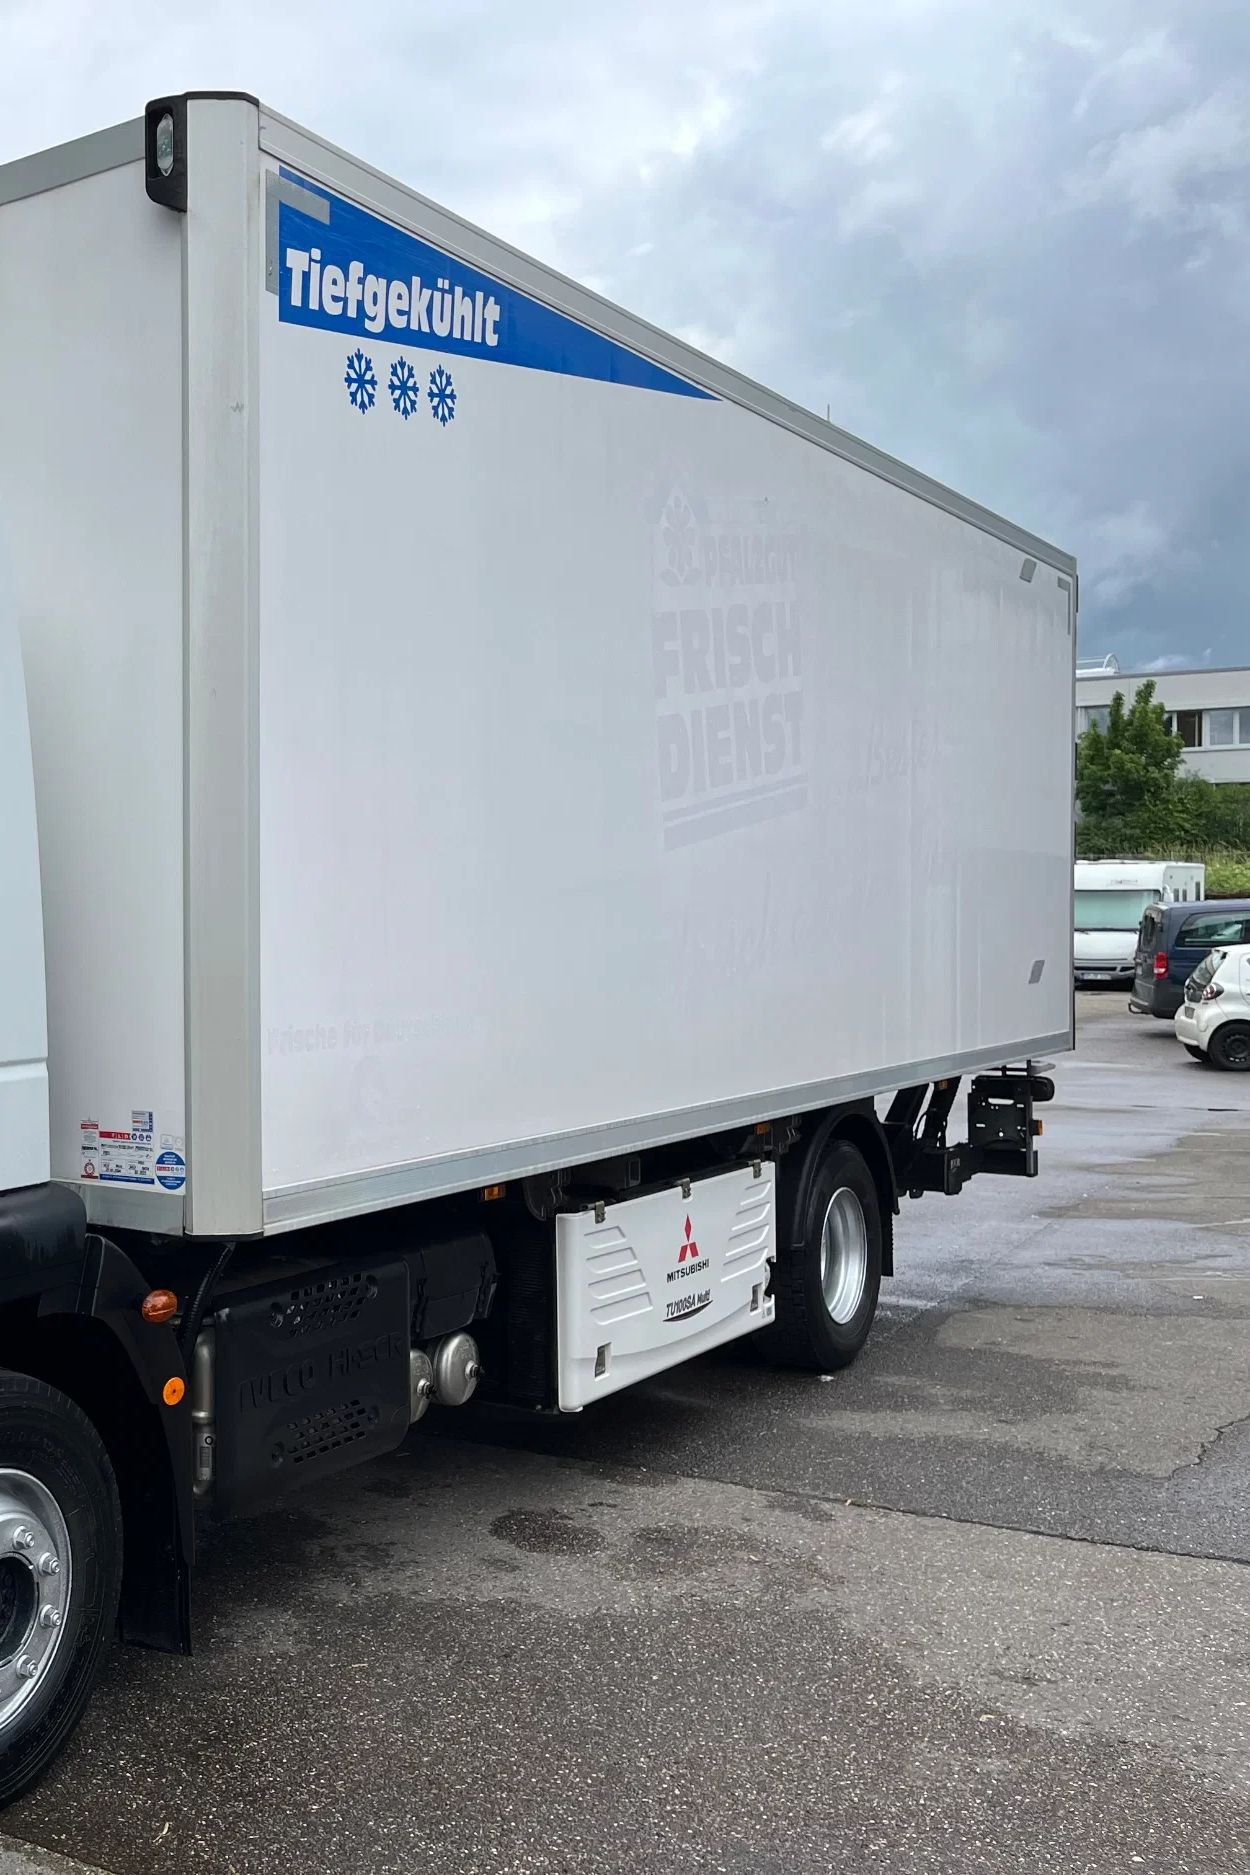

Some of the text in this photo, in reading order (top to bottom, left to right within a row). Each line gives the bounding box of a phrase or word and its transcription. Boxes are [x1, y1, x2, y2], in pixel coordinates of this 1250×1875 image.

[286, 247, 500, 347] Tiefgekühlt
[651, 600, 803, 699] FRISCH
[656, 690, 806, 802] DIENST
[666, 1258, 710, 1284] MITSUBISHI
